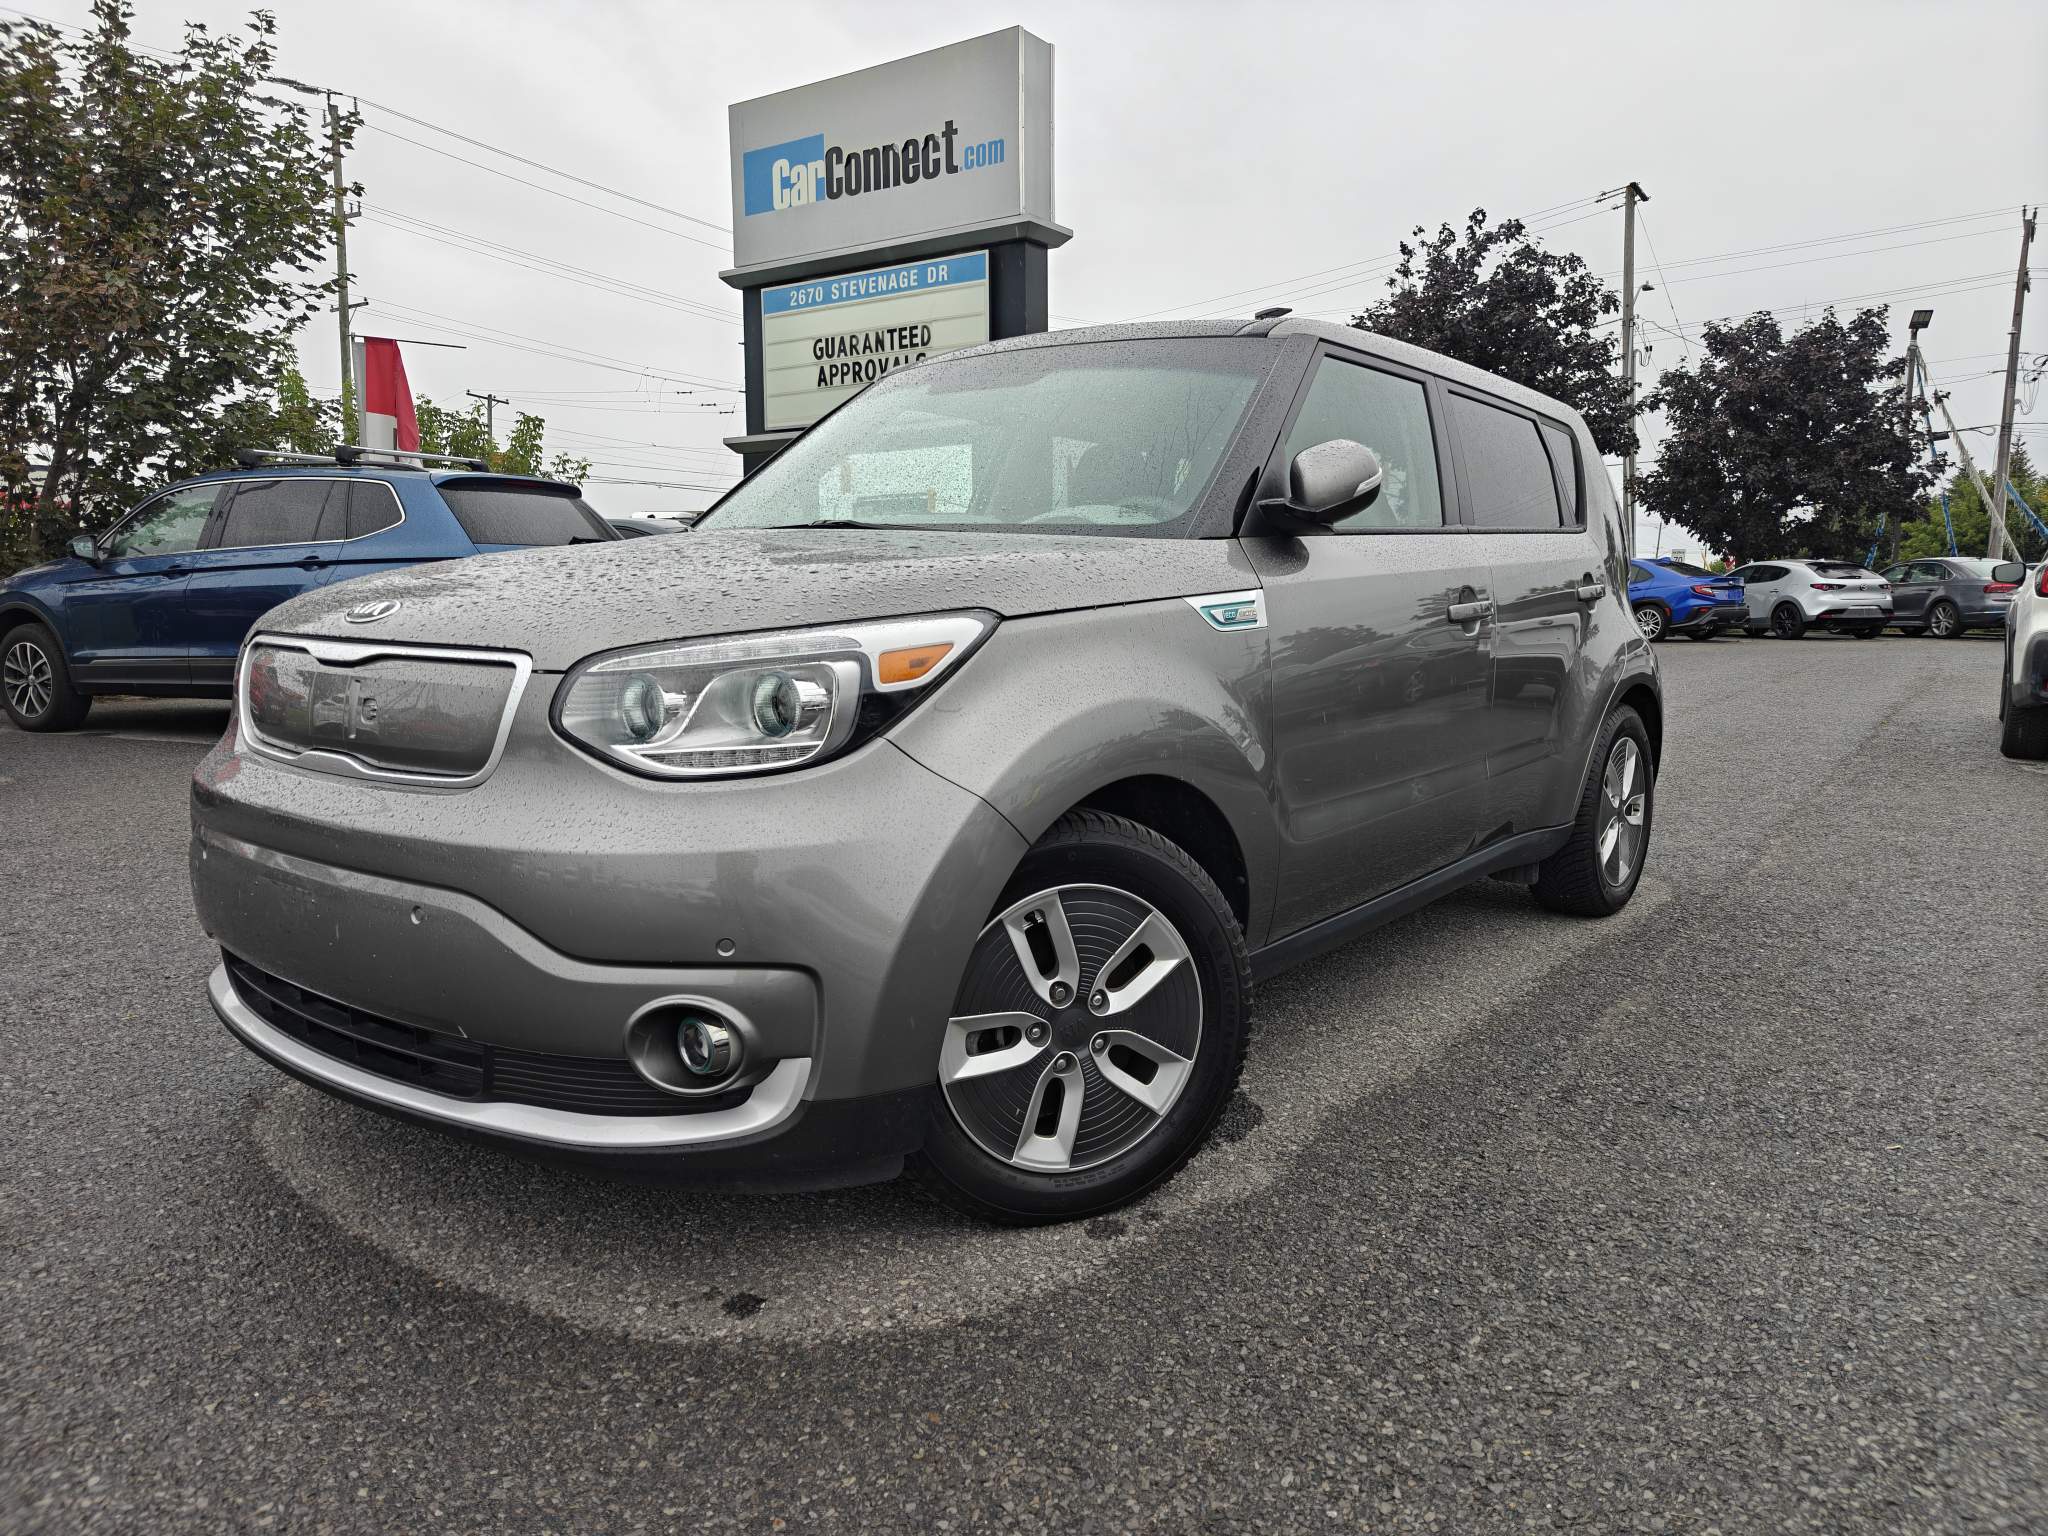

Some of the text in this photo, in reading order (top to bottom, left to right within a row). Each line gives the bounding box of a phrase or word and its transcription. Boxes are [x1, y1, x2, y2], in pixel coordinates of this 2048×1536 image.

[772, 119, 1005, 211] CarConnect.com
[790, 264, 948, 307] 2670 STEVENAGE DR
[813, 324, 931, 361] GUARANTEED
